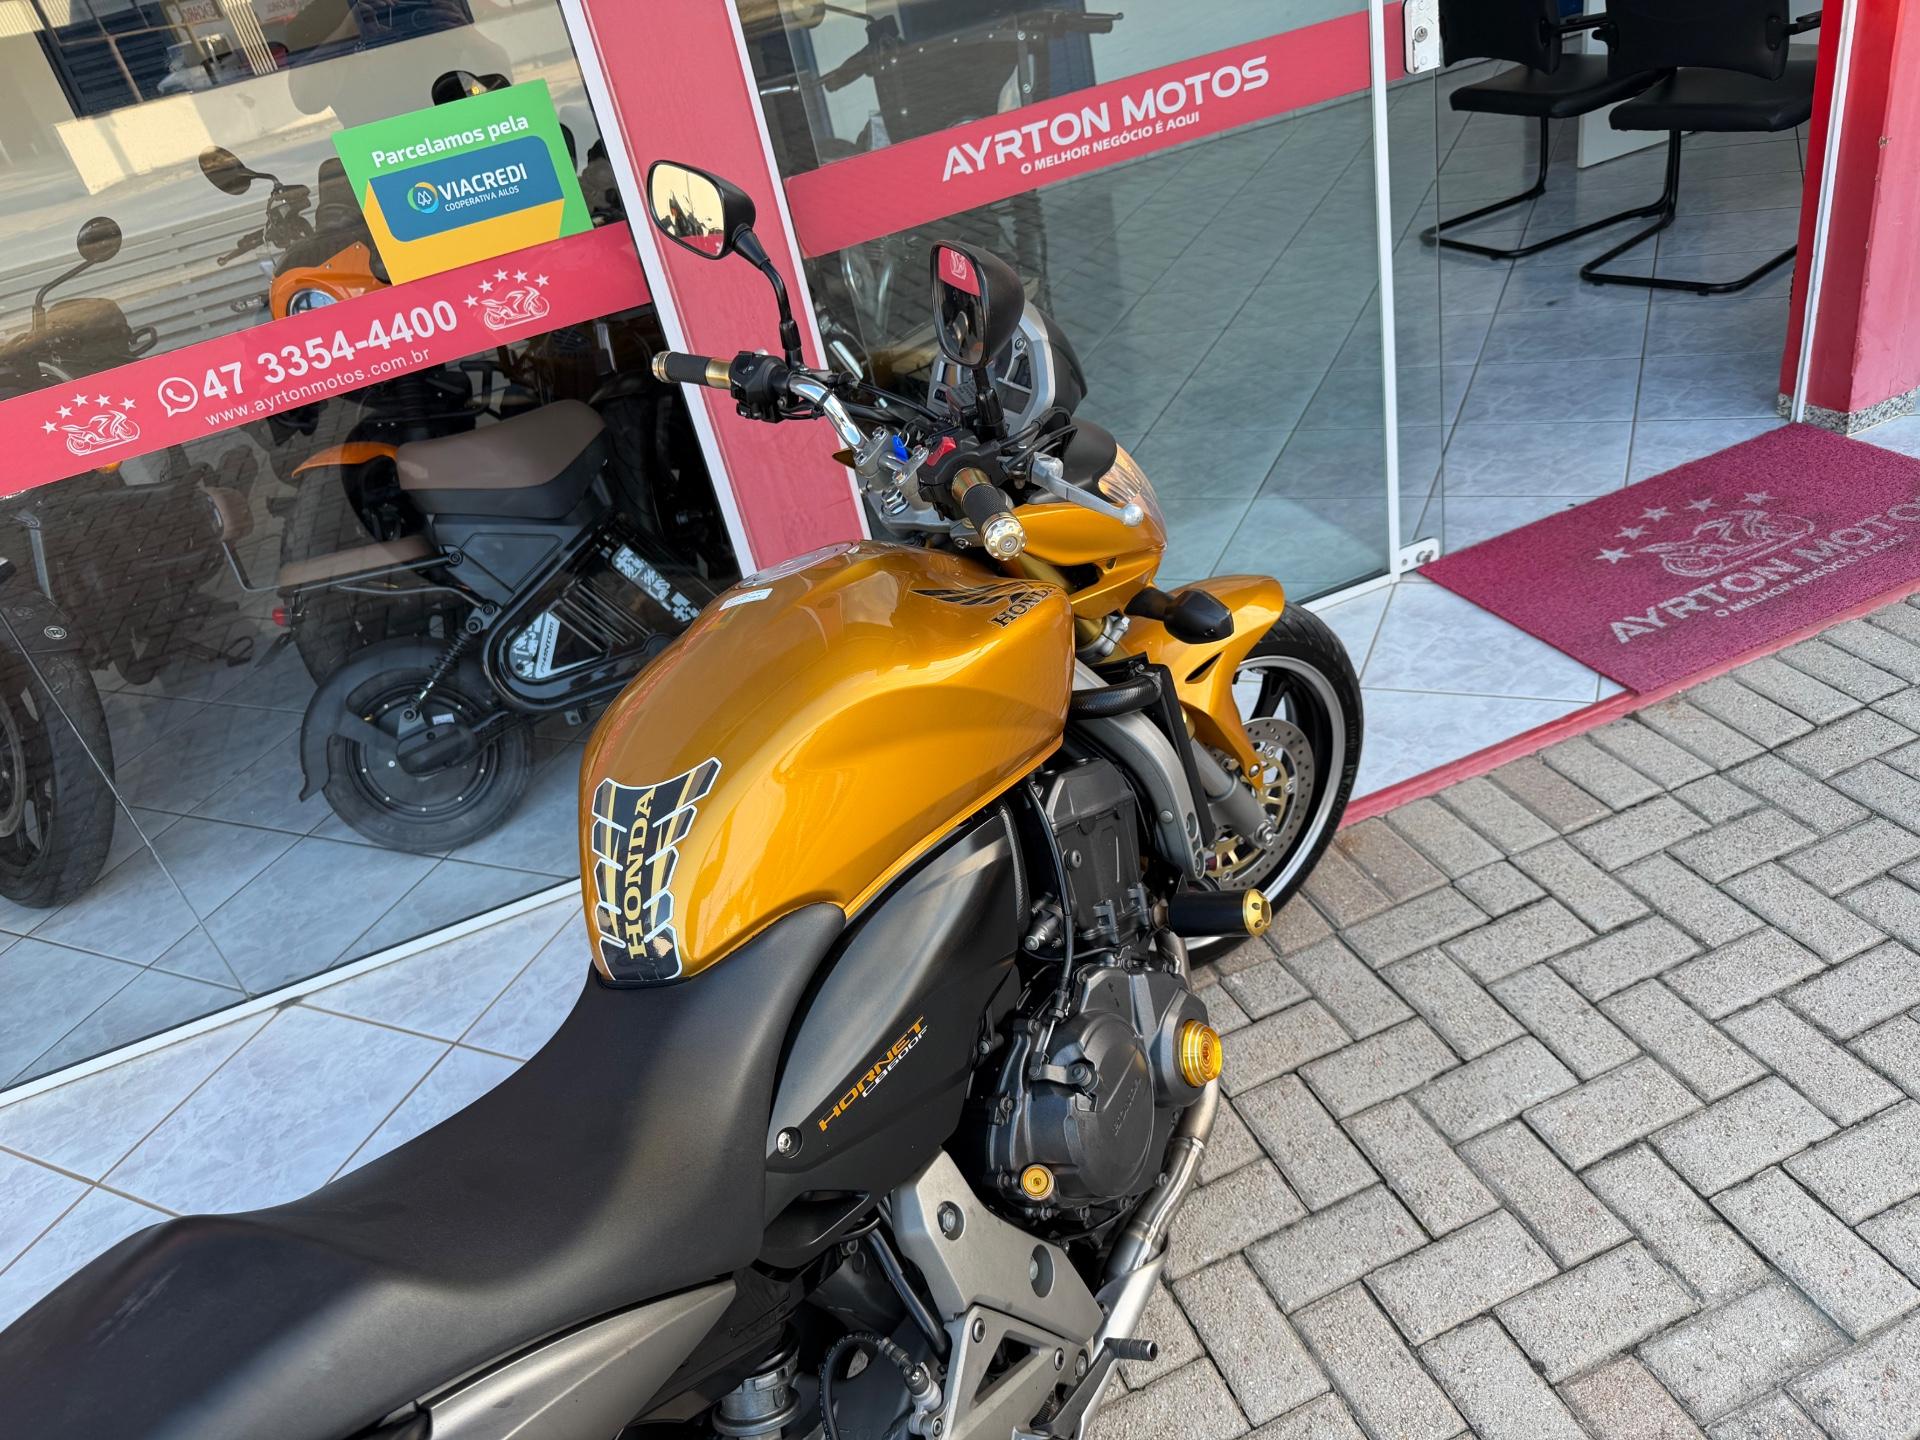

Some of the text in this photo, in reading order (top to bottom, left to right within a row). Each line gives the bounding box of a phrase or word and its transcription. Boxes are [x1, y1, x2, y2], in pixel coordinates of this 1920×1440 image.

[372, 115, 529, 168] Parcelamos pela
[942, 55, 1270, 182] AYRTON MOTOS
[1020, 111, 1200, 175] O MELHOR NEGÓCIO É AQUI
[437, 162, 528, 201] VIACREDI
[445, 185, 520, 212] COOPERATIVA AILOS
[202, 300, 458, 400] 47 3354-4400
[205, 347, 431, 427] www.ayrtonmotos.com.br
[990, 588, 1054, 627] HOND
[1610, 496, 1920, 644] AYRTON MOTO
[624, 785, 656, 960] HONDA
[818, 1016, 924, 1132] HORNET
[862, 1025, 928, 1098] CB600F
